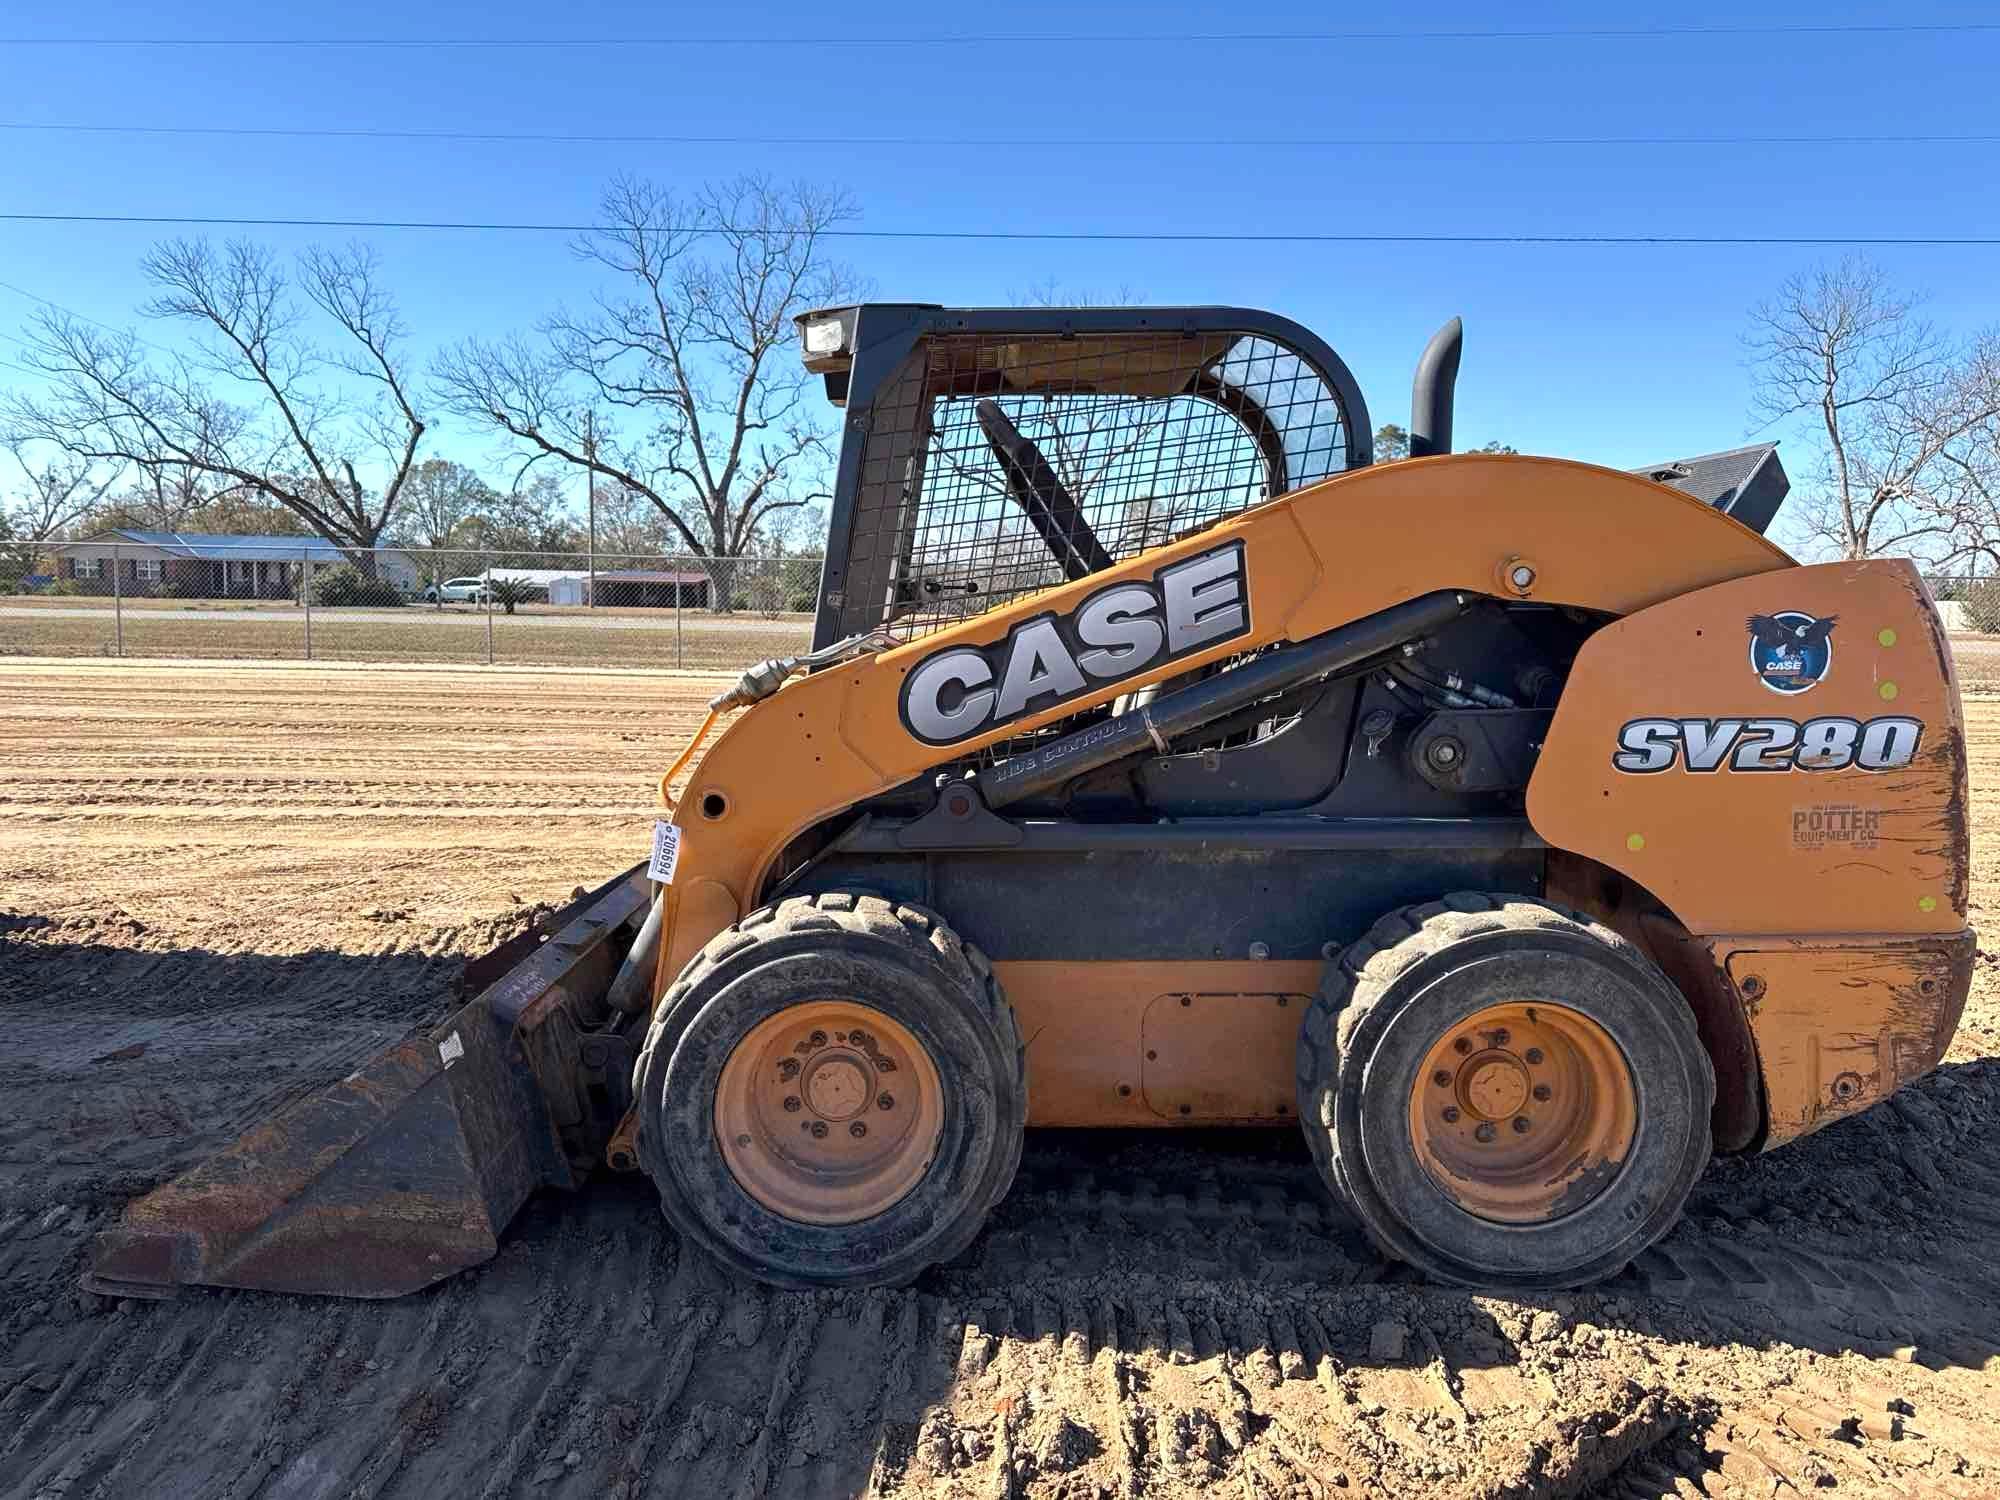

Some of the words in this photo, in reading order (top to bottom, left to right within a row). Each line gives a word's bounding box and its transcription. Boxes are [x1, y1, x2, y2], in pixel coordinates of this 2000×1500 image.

[901, 541, 1249, 745] CASE
[1765, 661, 1803, 671] CASE
[1613, 717, 1925, 773] SV280
[1792, 811, 1880, 831] POTTER
[1793, 830, 1857, 842] EQUIPMENT
[657, 835, 677, 876] 206694
